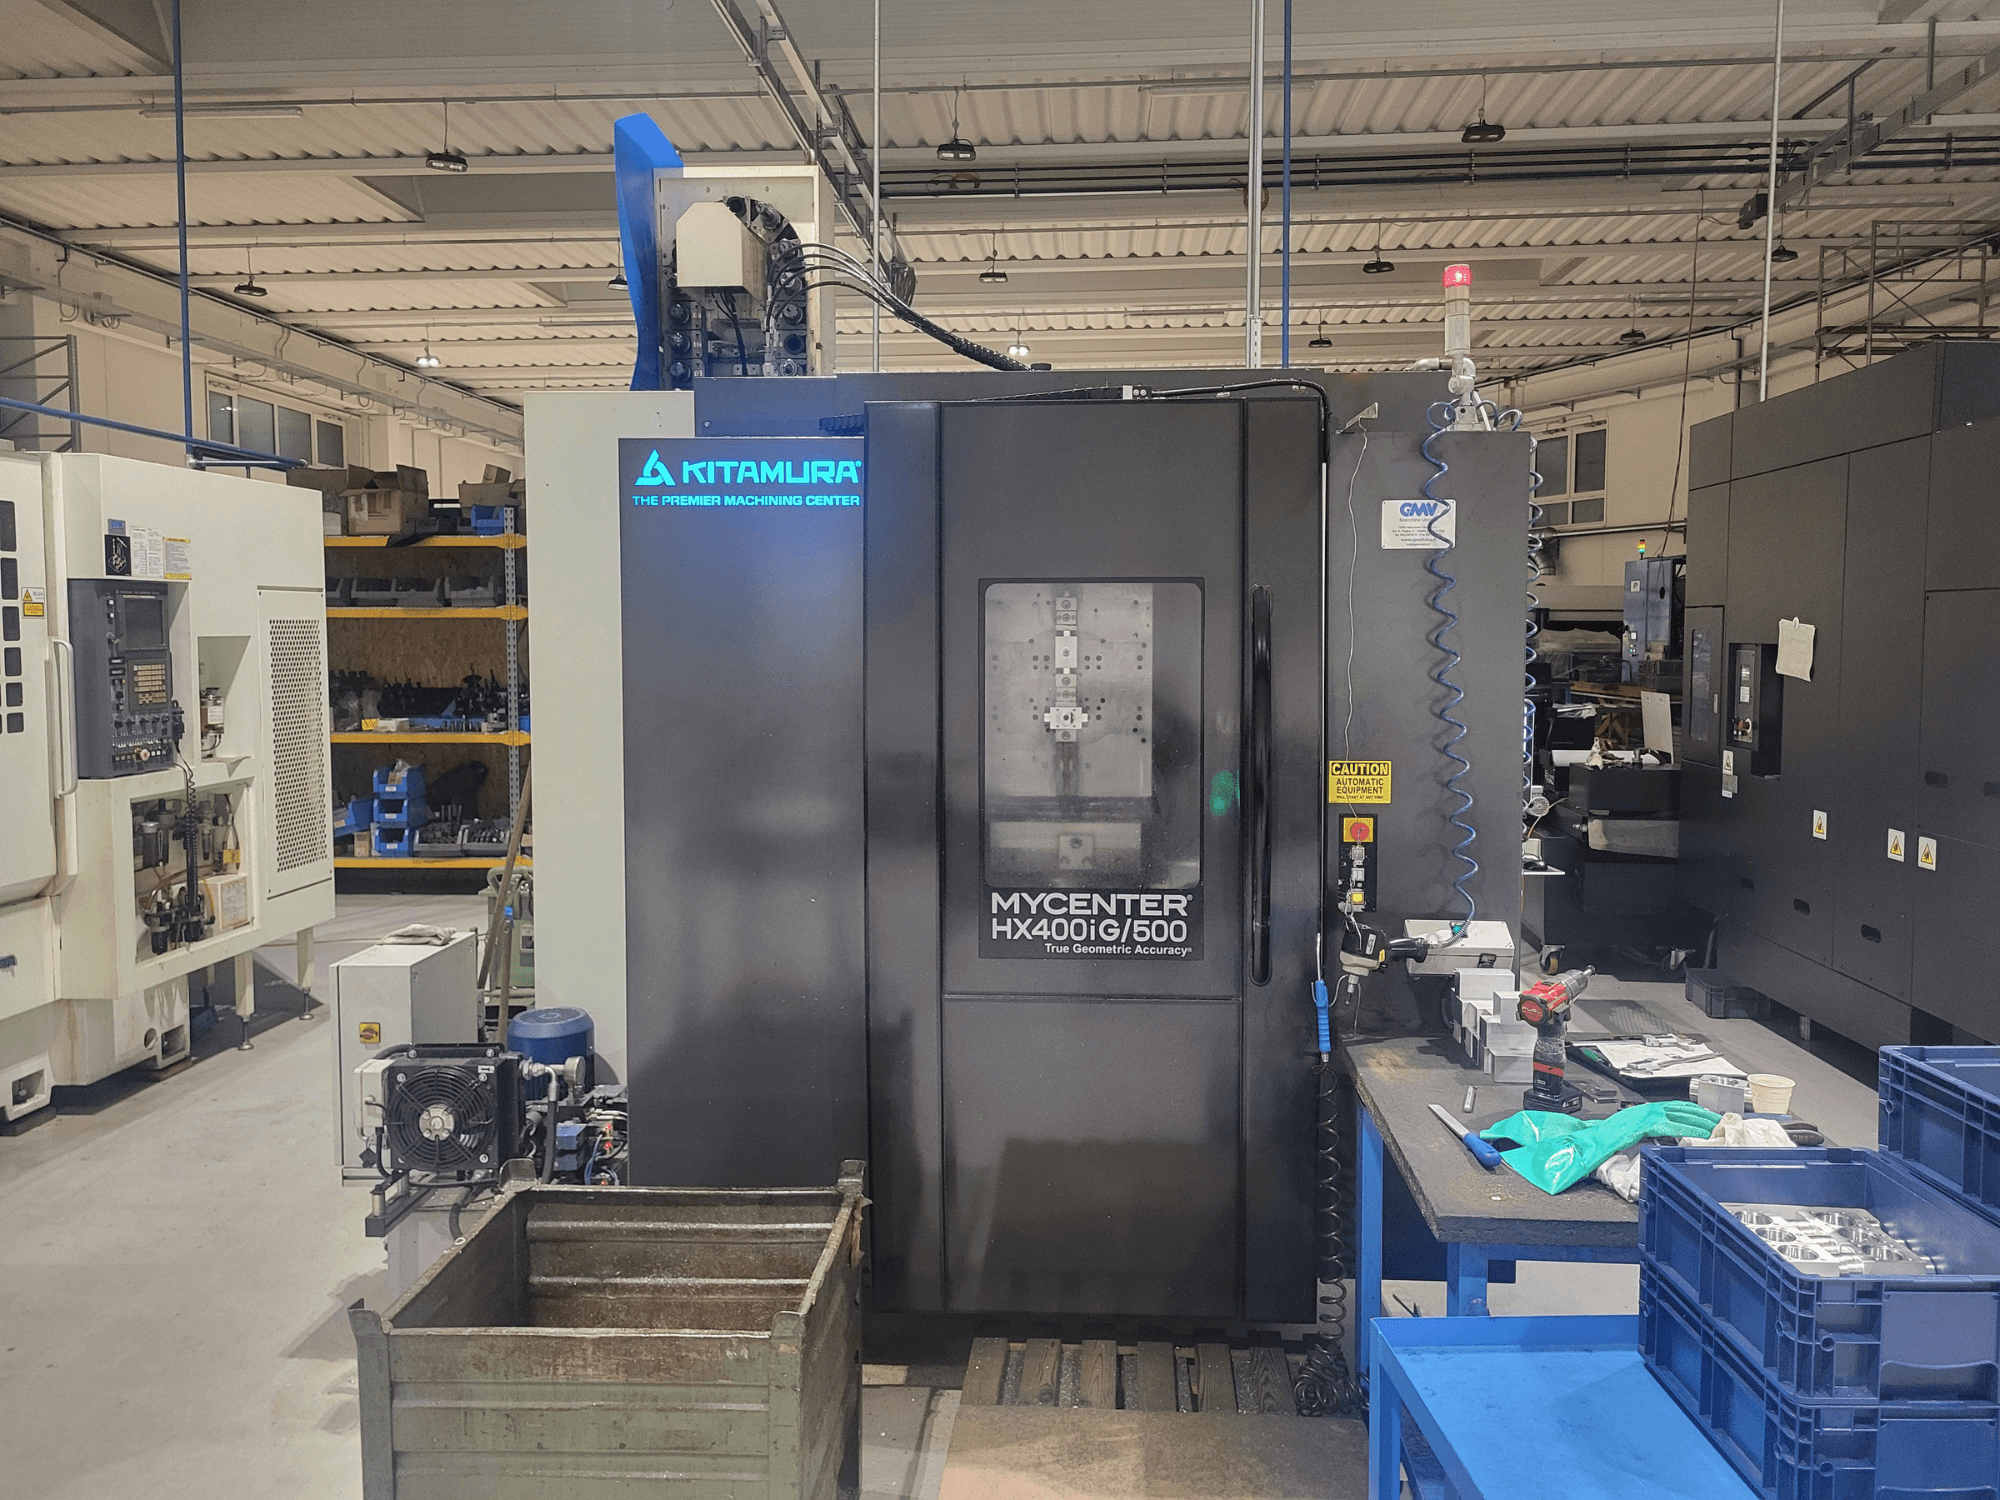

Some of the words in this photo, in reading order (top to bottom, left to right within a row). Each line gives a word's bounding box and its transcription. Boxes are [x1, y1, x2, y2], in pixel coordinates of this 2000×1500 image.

[631, 495, 659, 506] THE
[661, 495, 721, 506] PREMIER
[724, 495, 803, 506] MACHINING
[805, 495, 860, 506] CENTER
[1399, 502, 1438, 517] GMV
[1332, 763, 1388, 775] CAUTION
[1336, 777, 1384, 786] AUTOMATIC
[1336, 786, 1384, 795] EQUIPMENT
[991, 918, 1188, 943] HX400iG/500
[1045, 943, 1070, 954] True
[1072, 943, 1132, 955] Geometric
